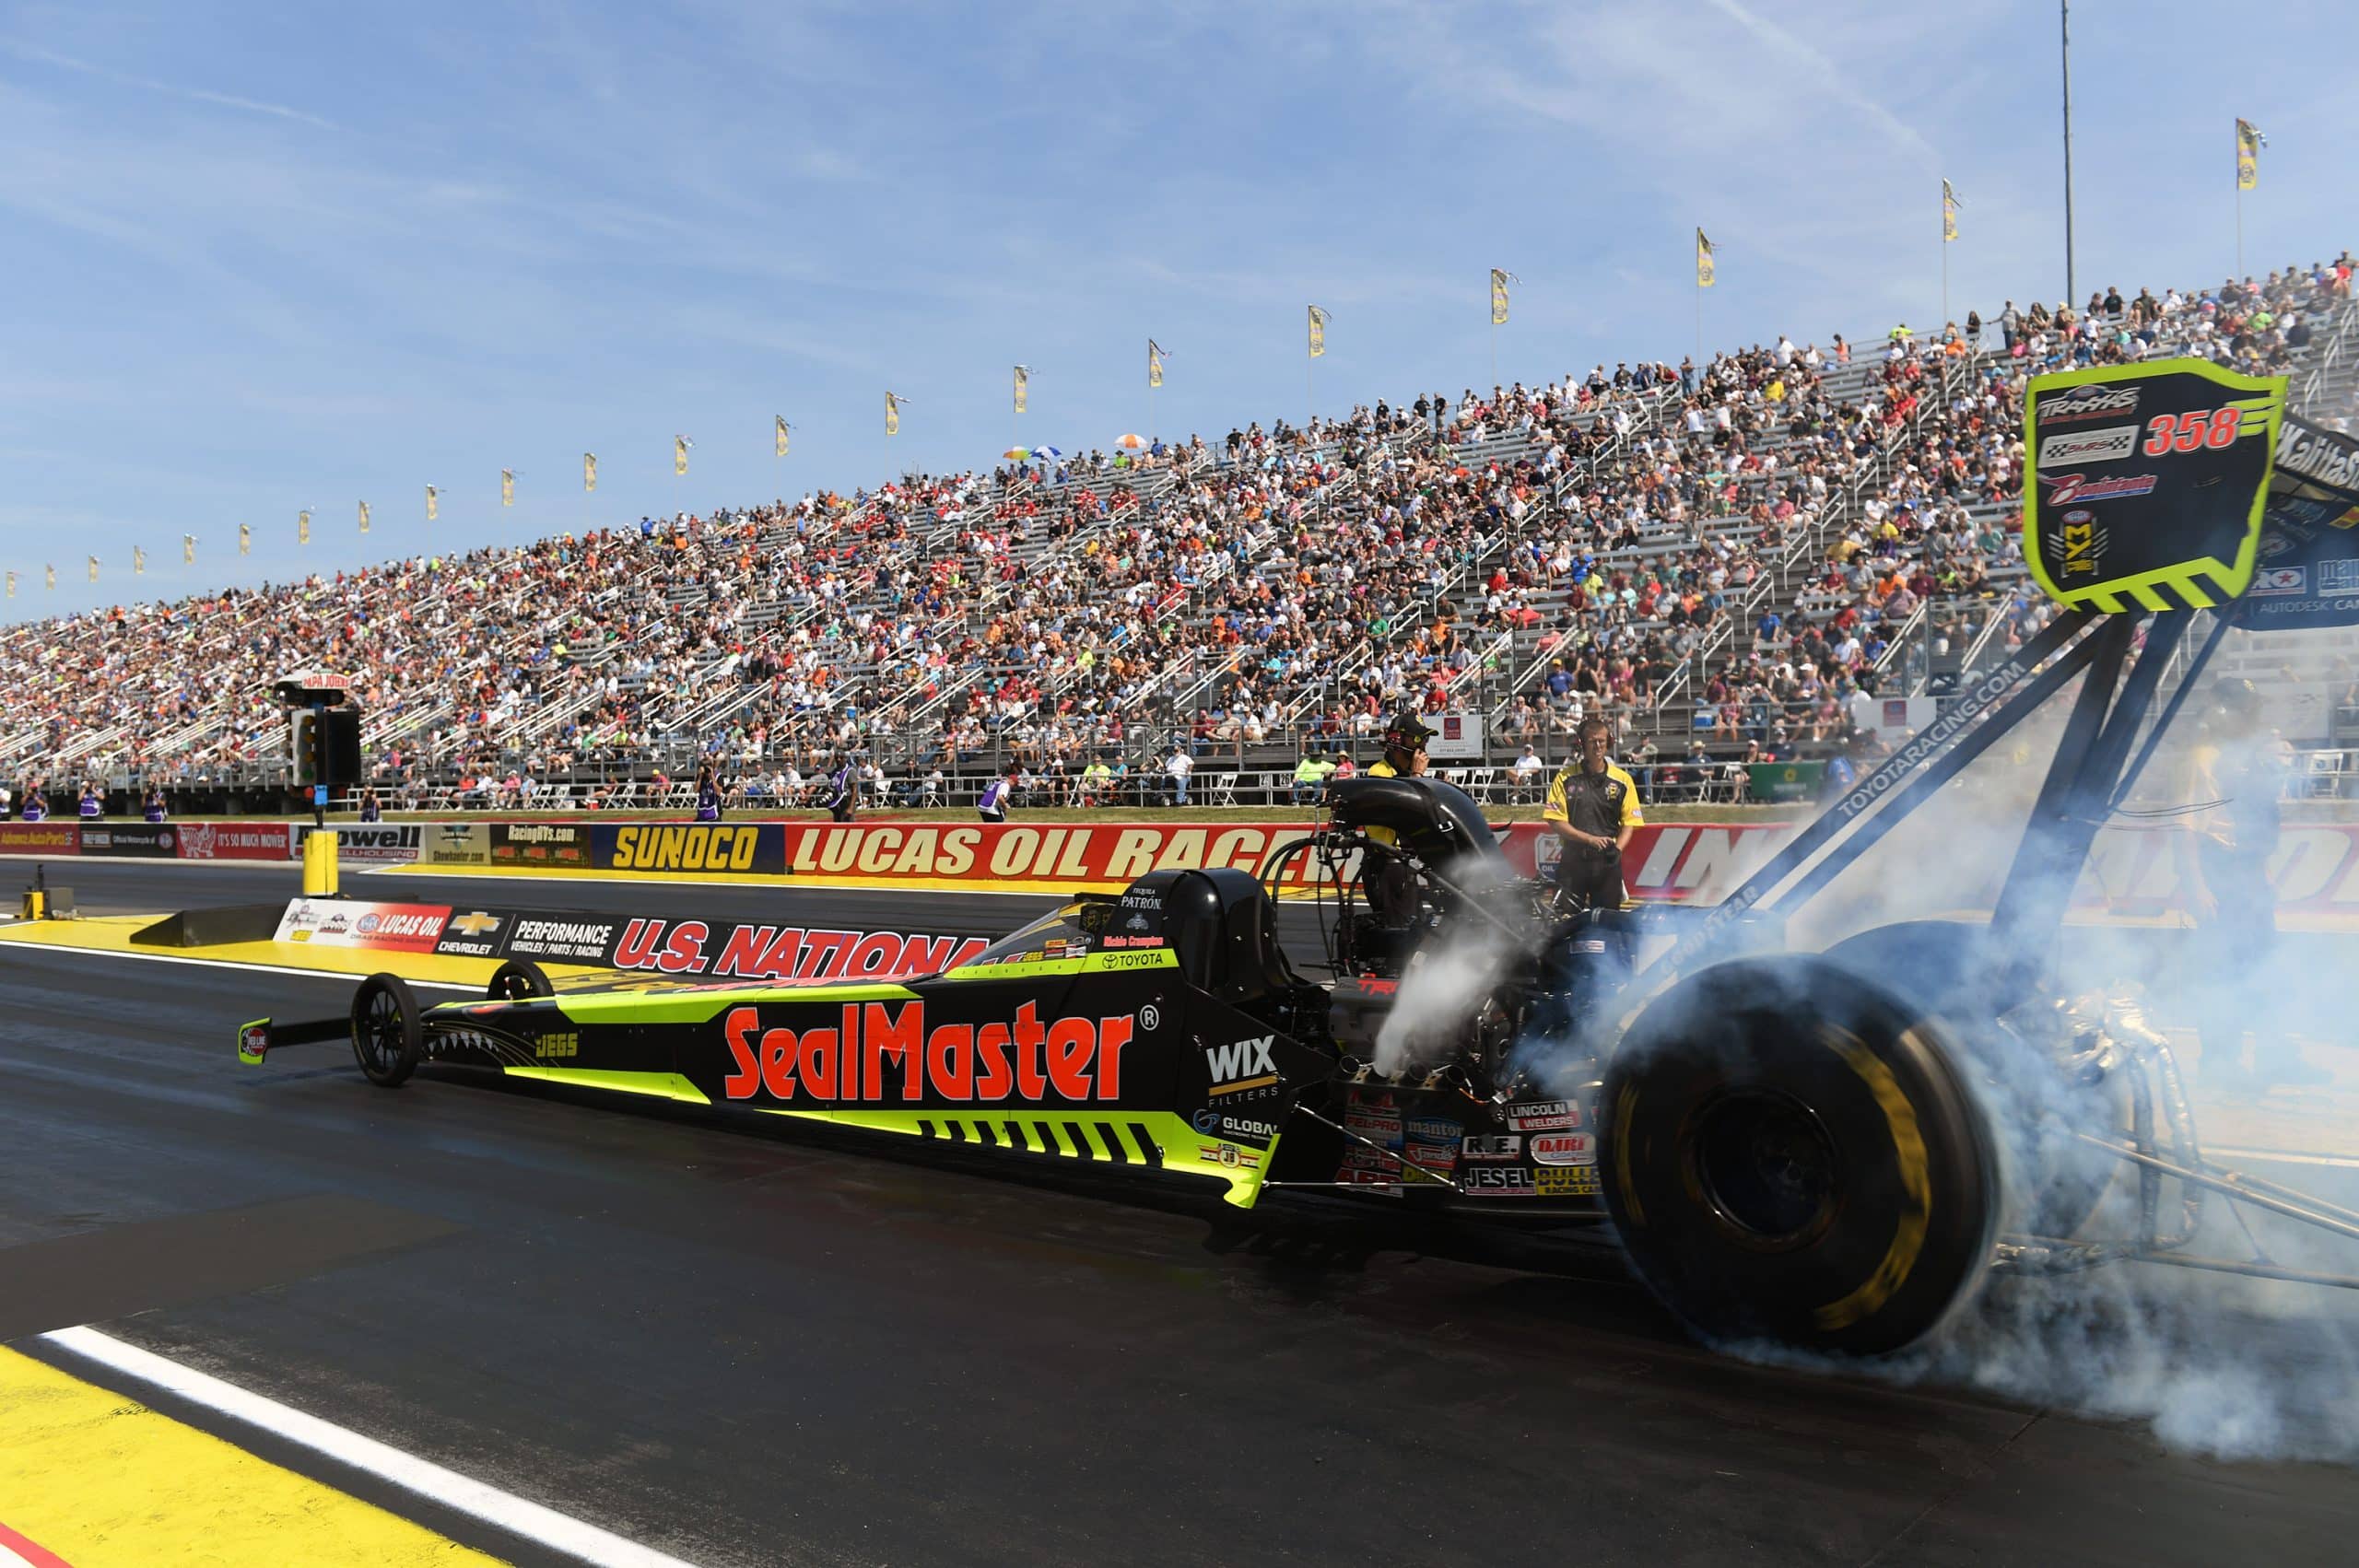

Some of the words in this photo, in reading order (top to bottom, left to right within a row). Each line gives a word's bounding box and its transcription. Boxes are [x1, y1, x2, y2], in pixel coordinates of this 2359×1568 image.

[2142, 407, 2241, 456] 358
[2259, 601, 2330, 614] AUTODESK
[1837, 661, 2025, 817] TOYOTARACING.COM
[230, 833, 241, 848] SO
[509, 825, 574, 843] RacingRVs.com
[337, 849, 417, 859] ELLHOUSING
[613, 826, 759, 870] SUNOCO
[793, 828, 981, 875] LUCAS
[989, 828, 1093, 879] OIL
[1121, 895, 1161, 910] PATRÓN
[377, 914, 421, 936] LUCAS
[418, 918, 444, 938] OIL
[514, 920, 613, 945] PERFORMANCE
[438, 941, 493, 955] CHEVROLET
[511, 940, 543, 954] VEHICLES
[614, 919, 710, 977] U.S.
[1120, 954, 1163, 967] TOYOTA
[535, 1033, 579, 1057] JEGS
[724, 999, 1134, 1101] SealMaster
[1206, 1035, 1277, 1082] WIX
[1208, 1087, 1278, 1107] FILTERS
[1509, 1104, 1567, 1117] LINCOLN
[1525, 1117, 1574, 1129] WELDERS
[1465, 1167, 1534, 1188] JESEL
